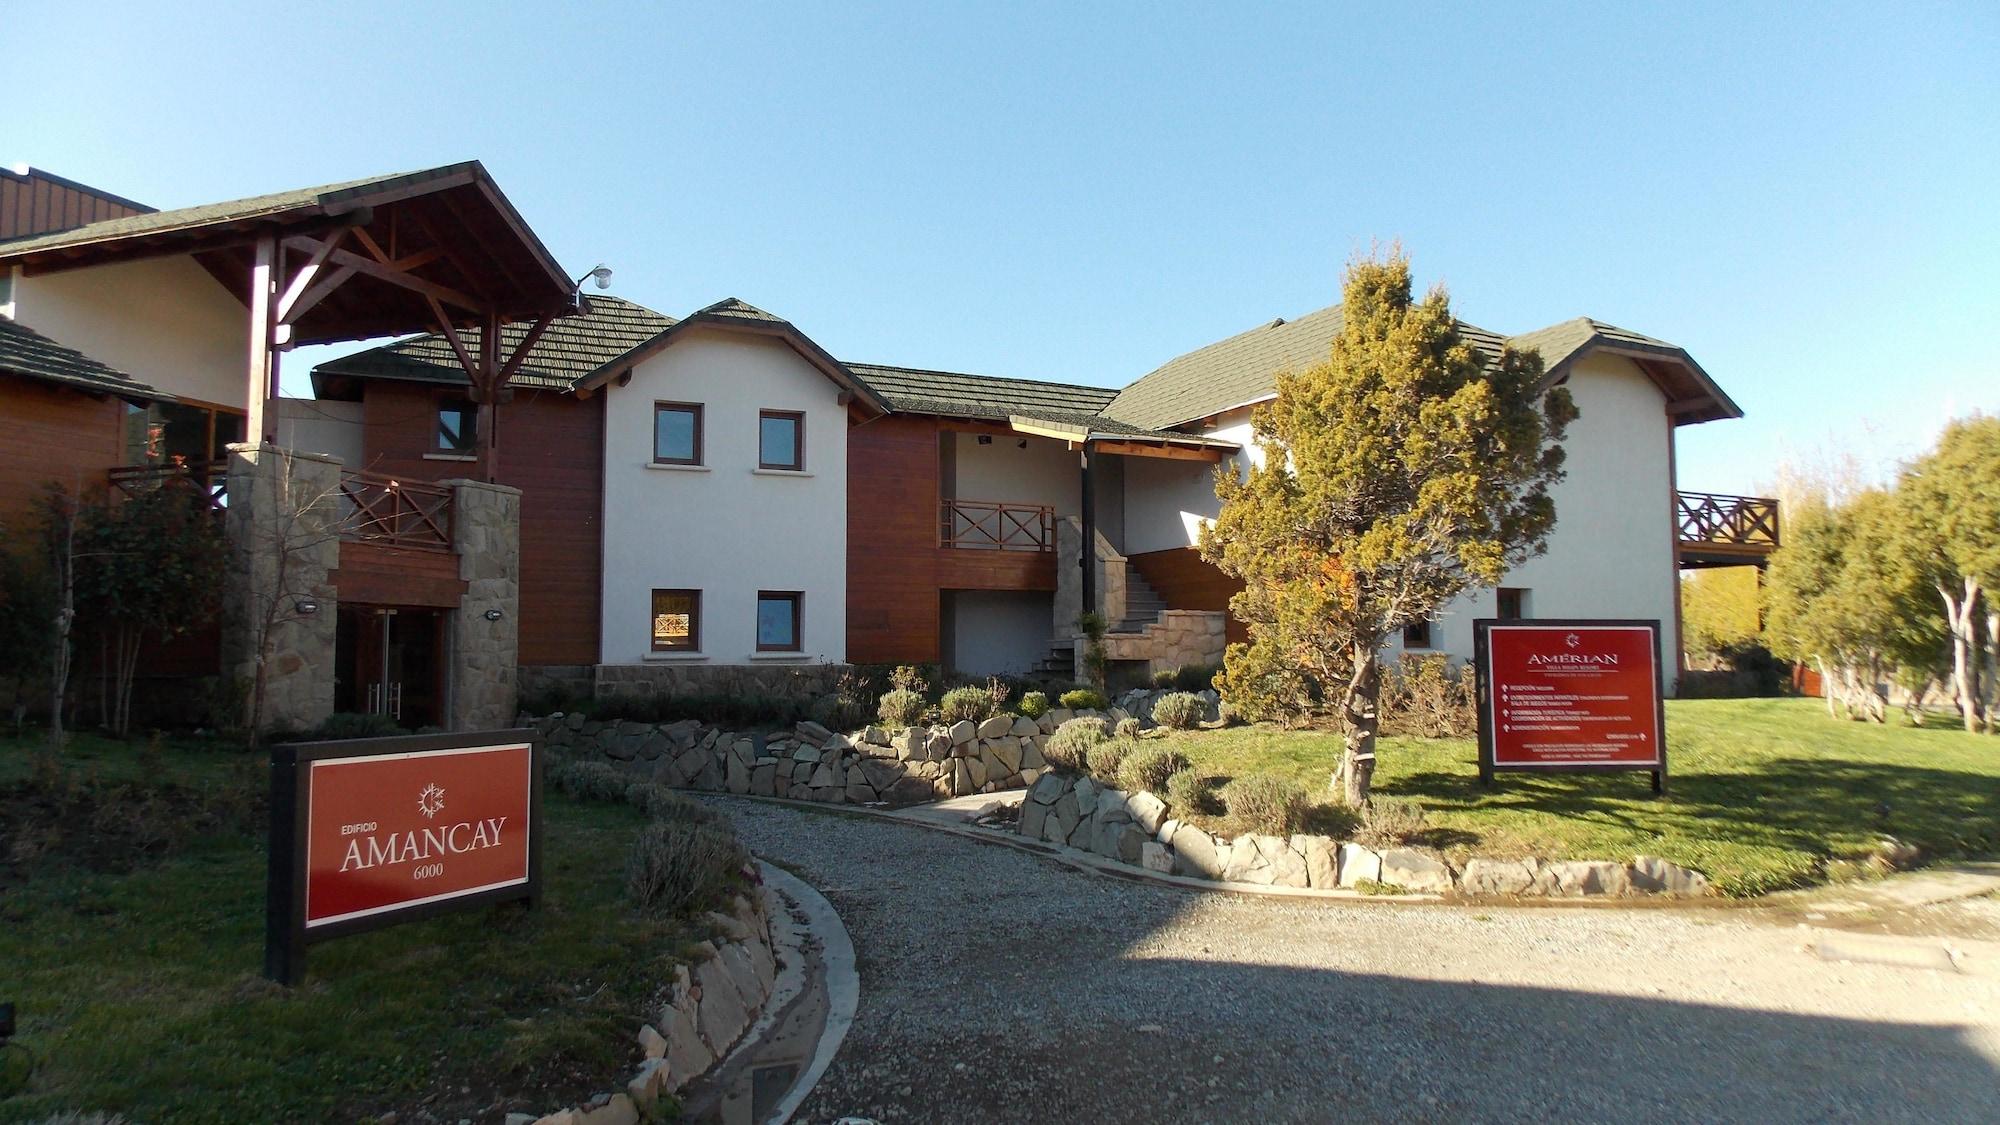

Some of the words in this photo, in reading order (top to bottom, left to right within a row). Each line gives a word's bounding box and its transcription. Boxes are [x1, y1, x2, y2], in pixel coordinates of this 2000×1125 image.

[341, 822, 377, 835] EDIFICIO
[339, 816, 507, 872] AMANCAY
[413, 863, 444, 880] 6000
